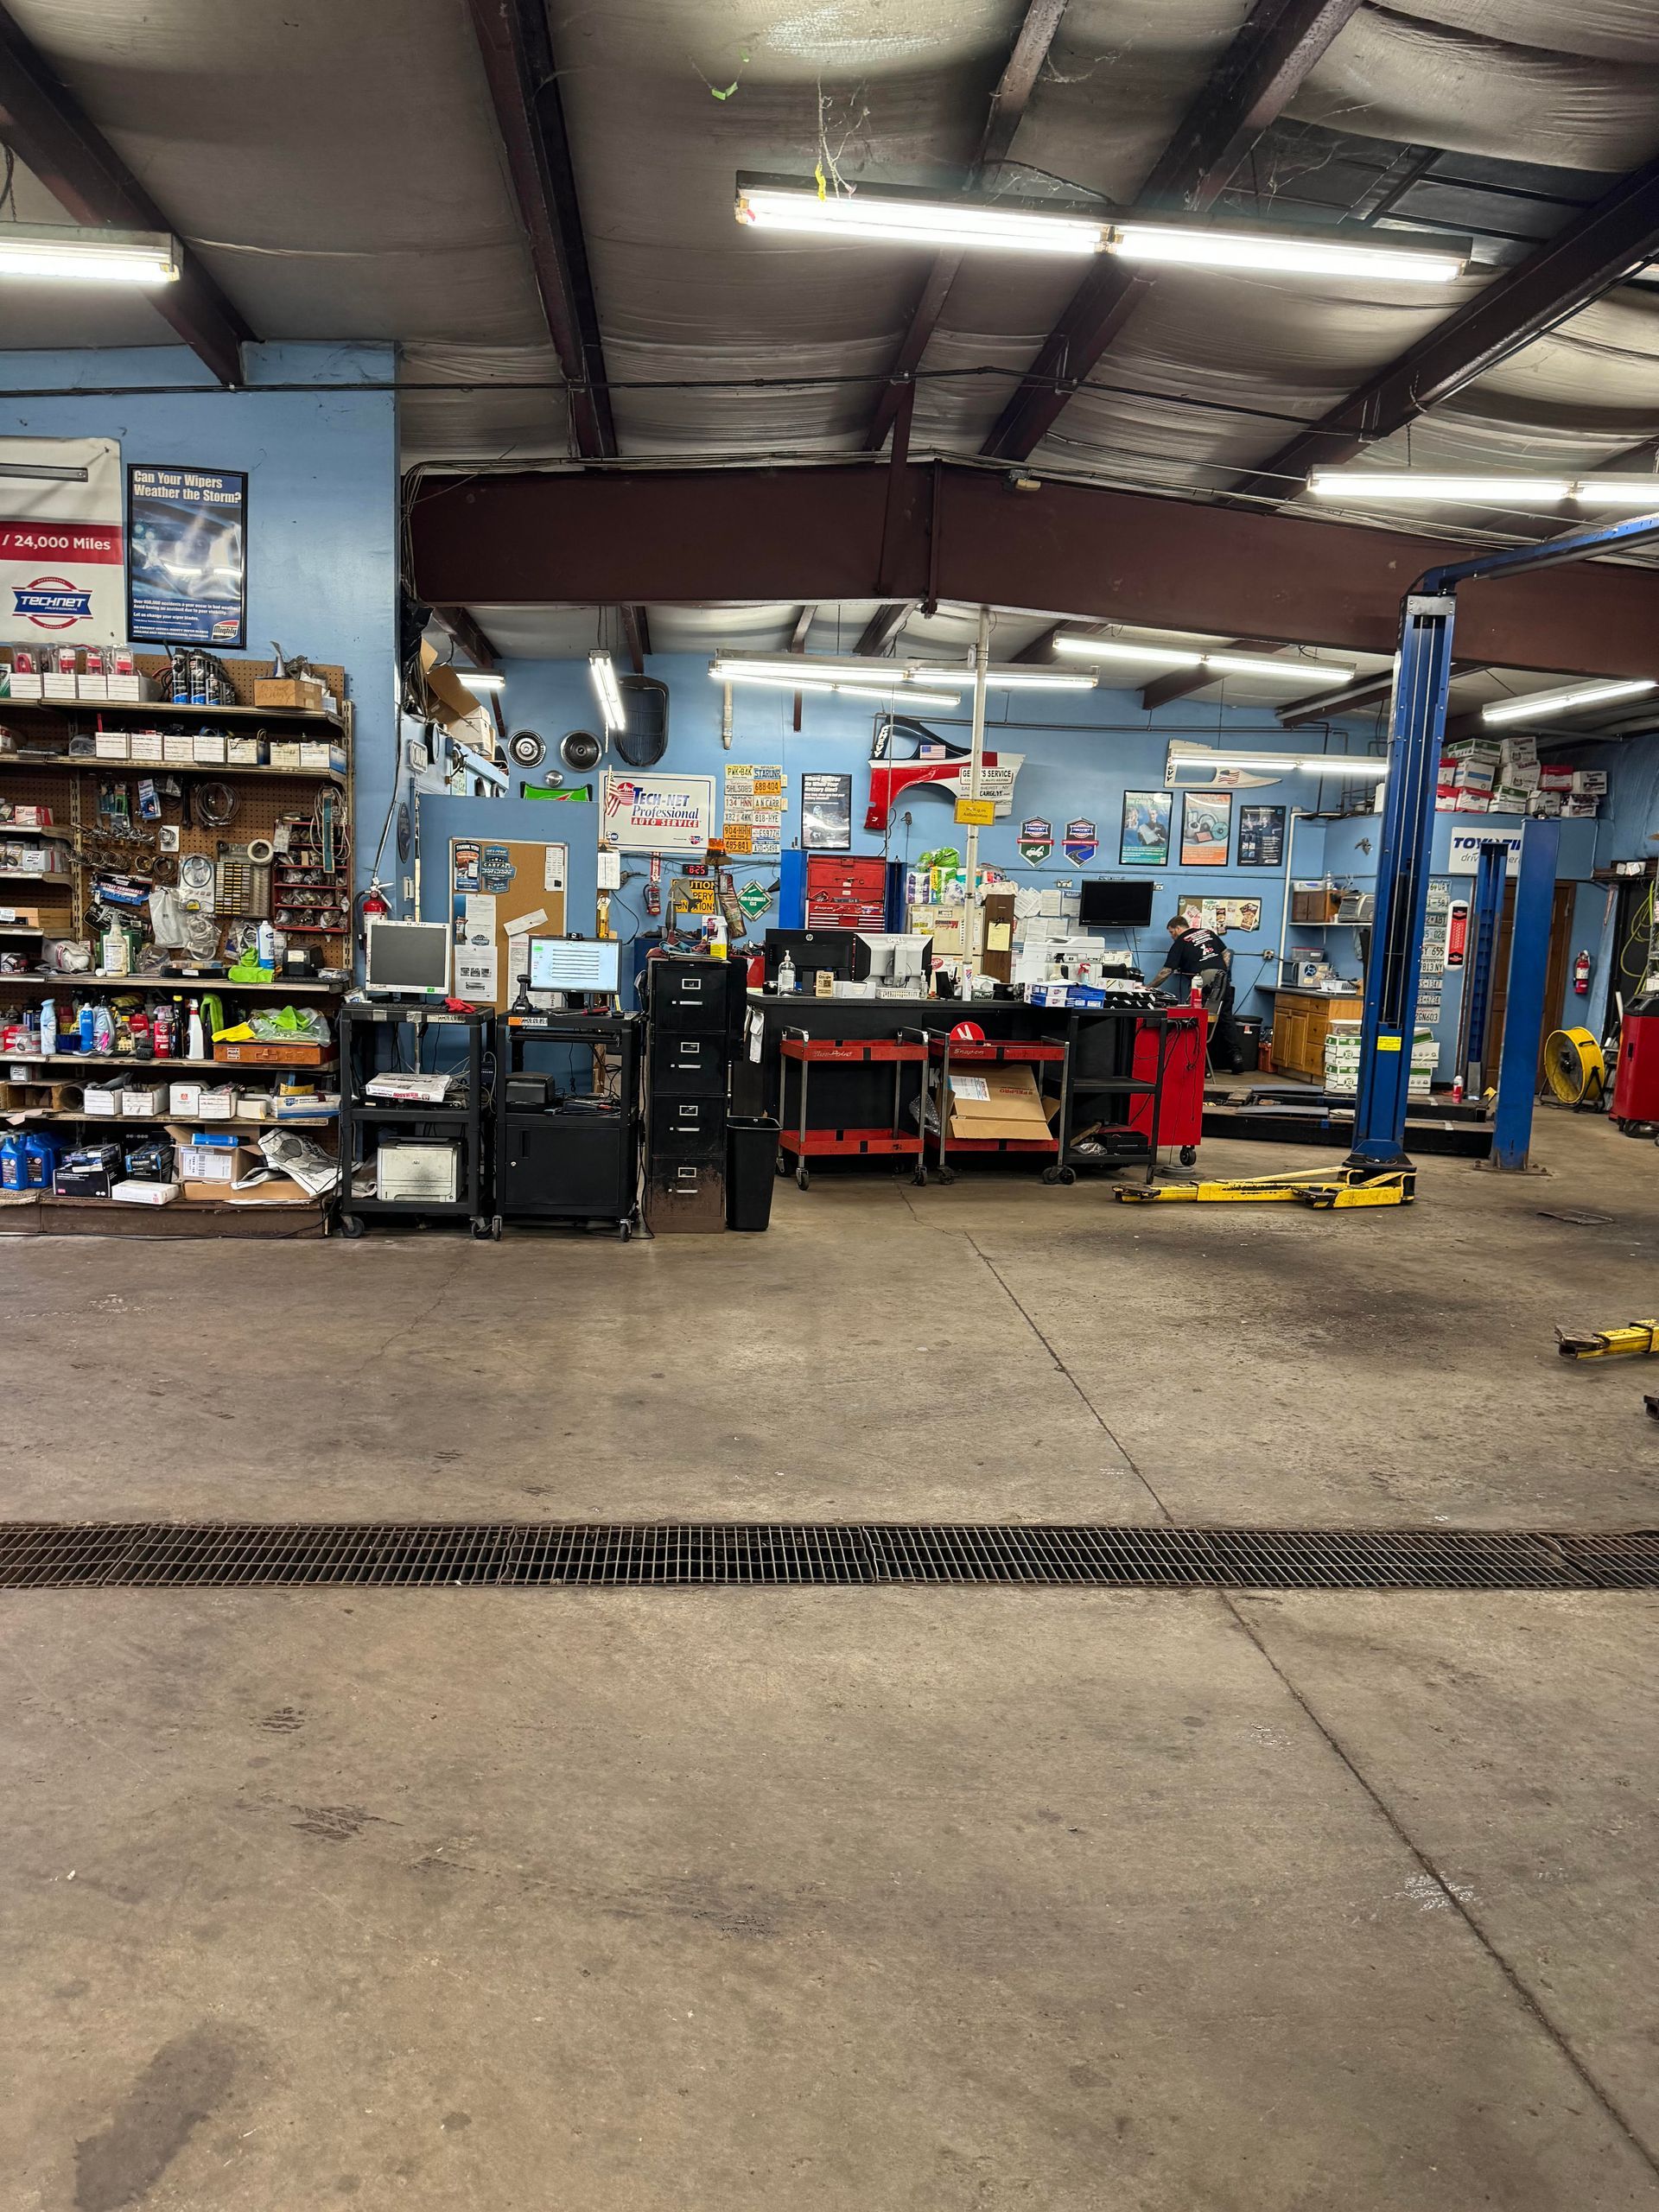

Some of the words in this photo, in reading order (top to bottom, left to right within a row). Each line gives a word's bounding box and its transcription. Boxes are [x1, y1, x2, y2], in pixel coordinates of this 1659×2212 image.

[134, 470, 155, 483] Can
[157, 472, 181, 485] Your
[184, 474, 223, 489] Wipers
[134, 484, 180, 499] Weather
[182, 488, 200, 500] the
[203, 489, 242, 504] Storm?
[14, 535, 69, 550] 24,000
[73, 537, 111, 550] Miles
[20, 595, 86, 607] TECHNET
[633, 787, 690, 806] TECH-NET
[632, 804, 699, 820] Professional
[660, 819, 699, 828] SERVICE
